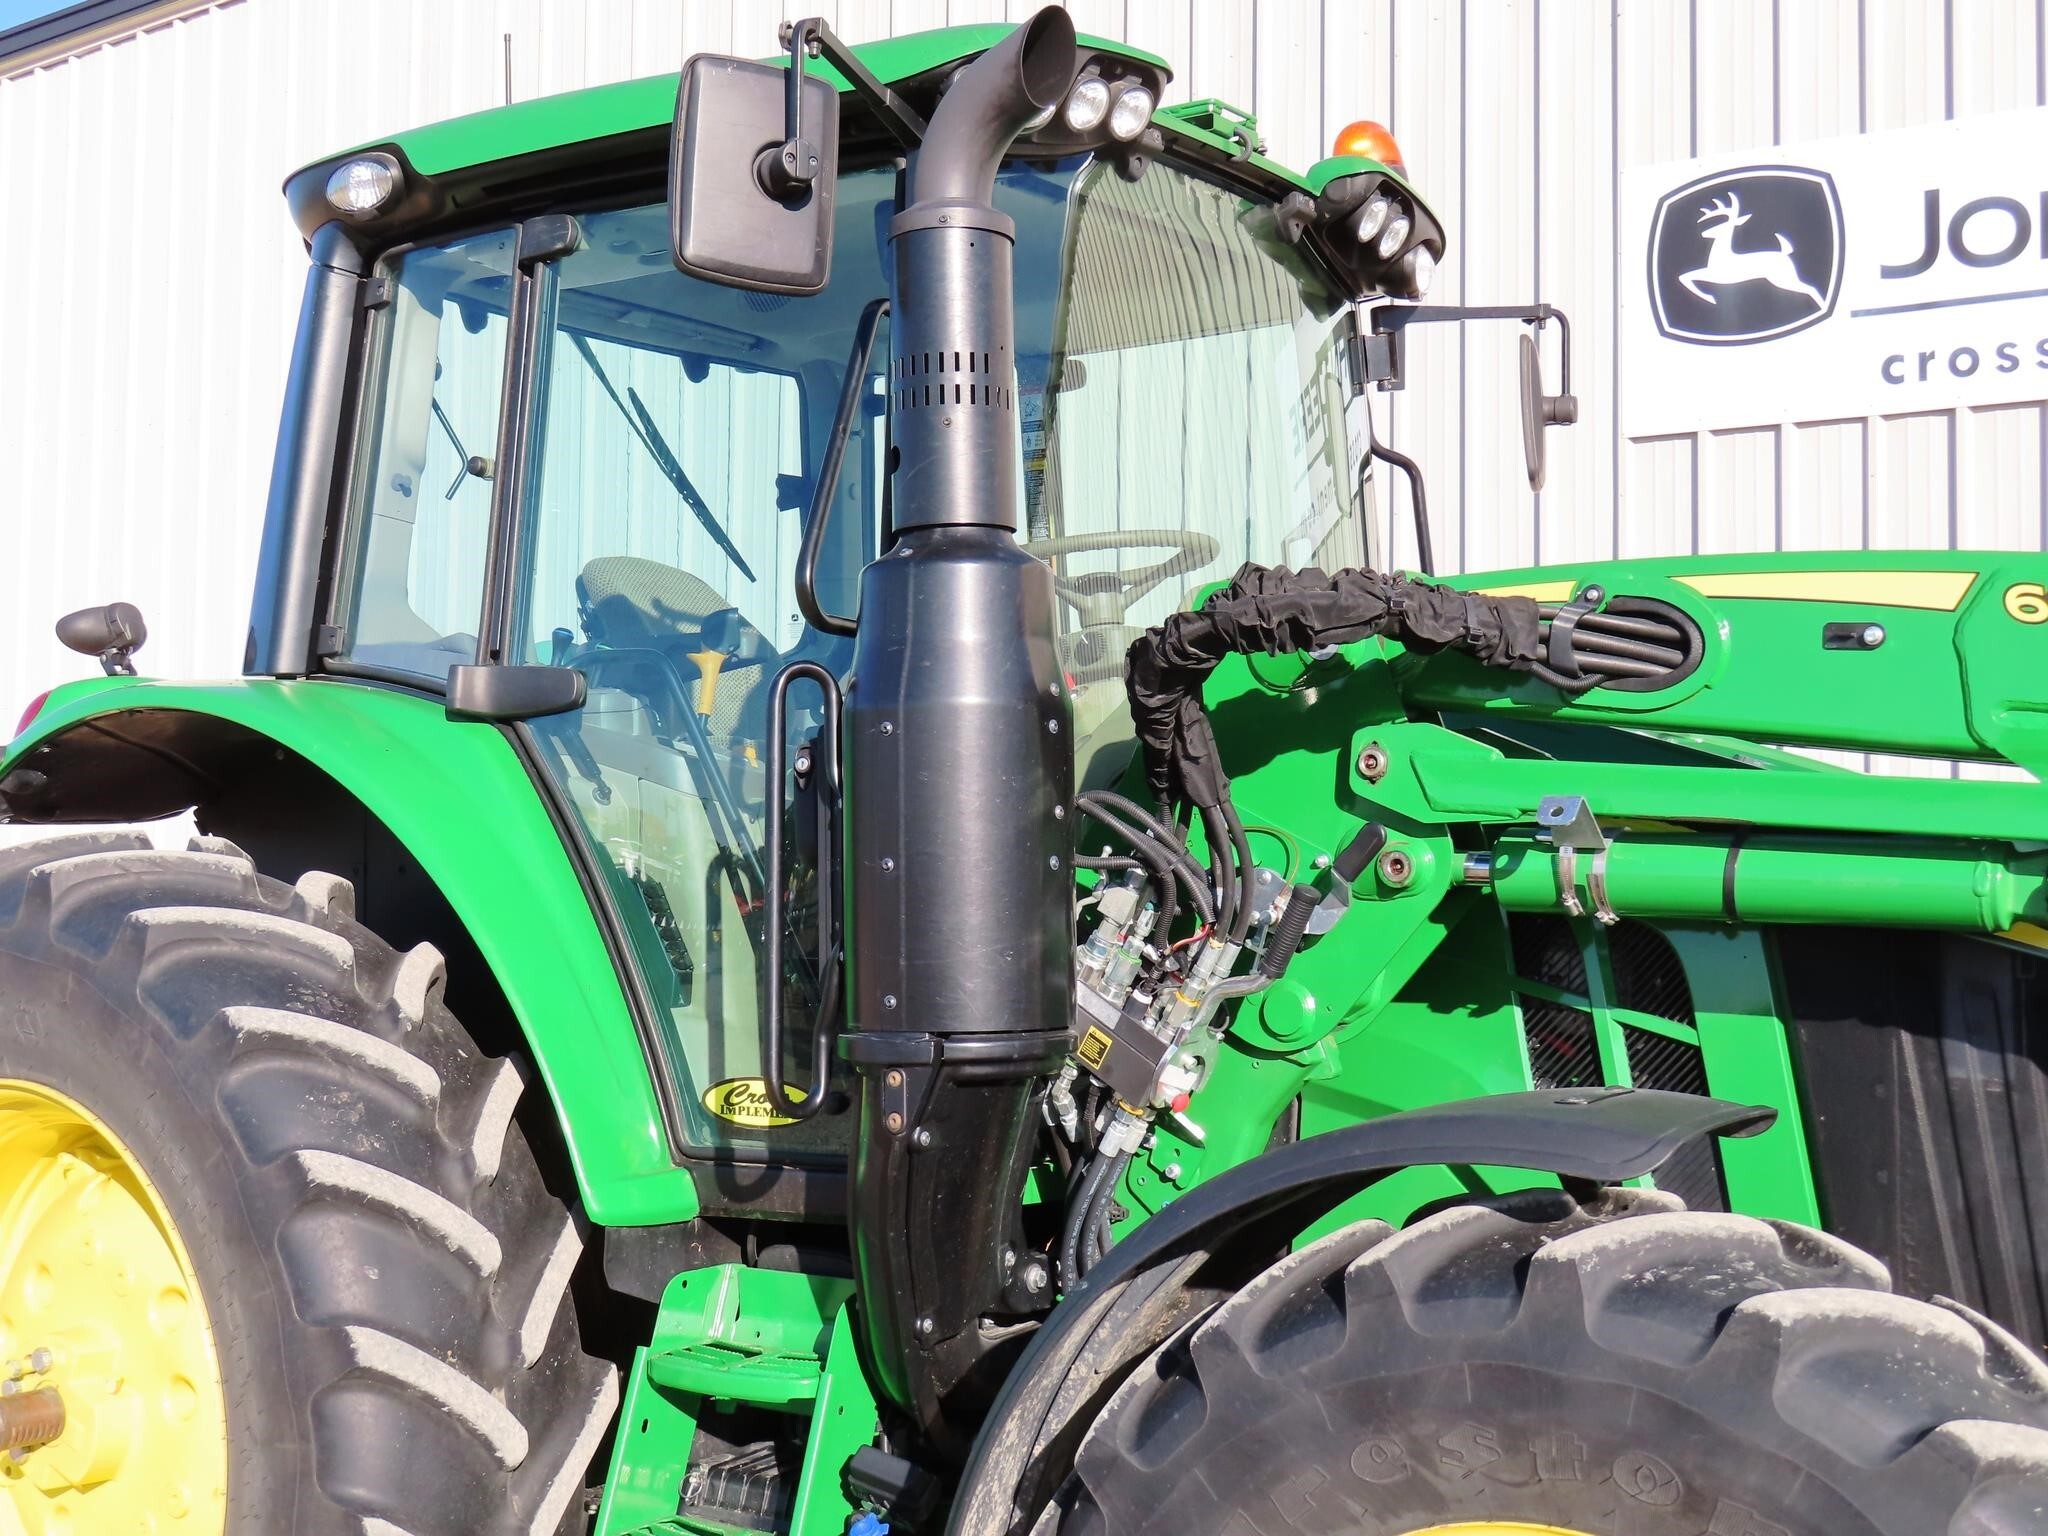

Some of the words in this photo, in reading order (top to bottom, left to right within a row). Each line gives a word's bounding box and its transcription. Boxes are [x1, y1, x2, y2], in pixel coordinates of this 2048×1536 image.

[1880, 189, 2048, 279] JO
[723, 1083, 786, 1107] Cro
[719, 1104, 785, 1118] IMPLEM
